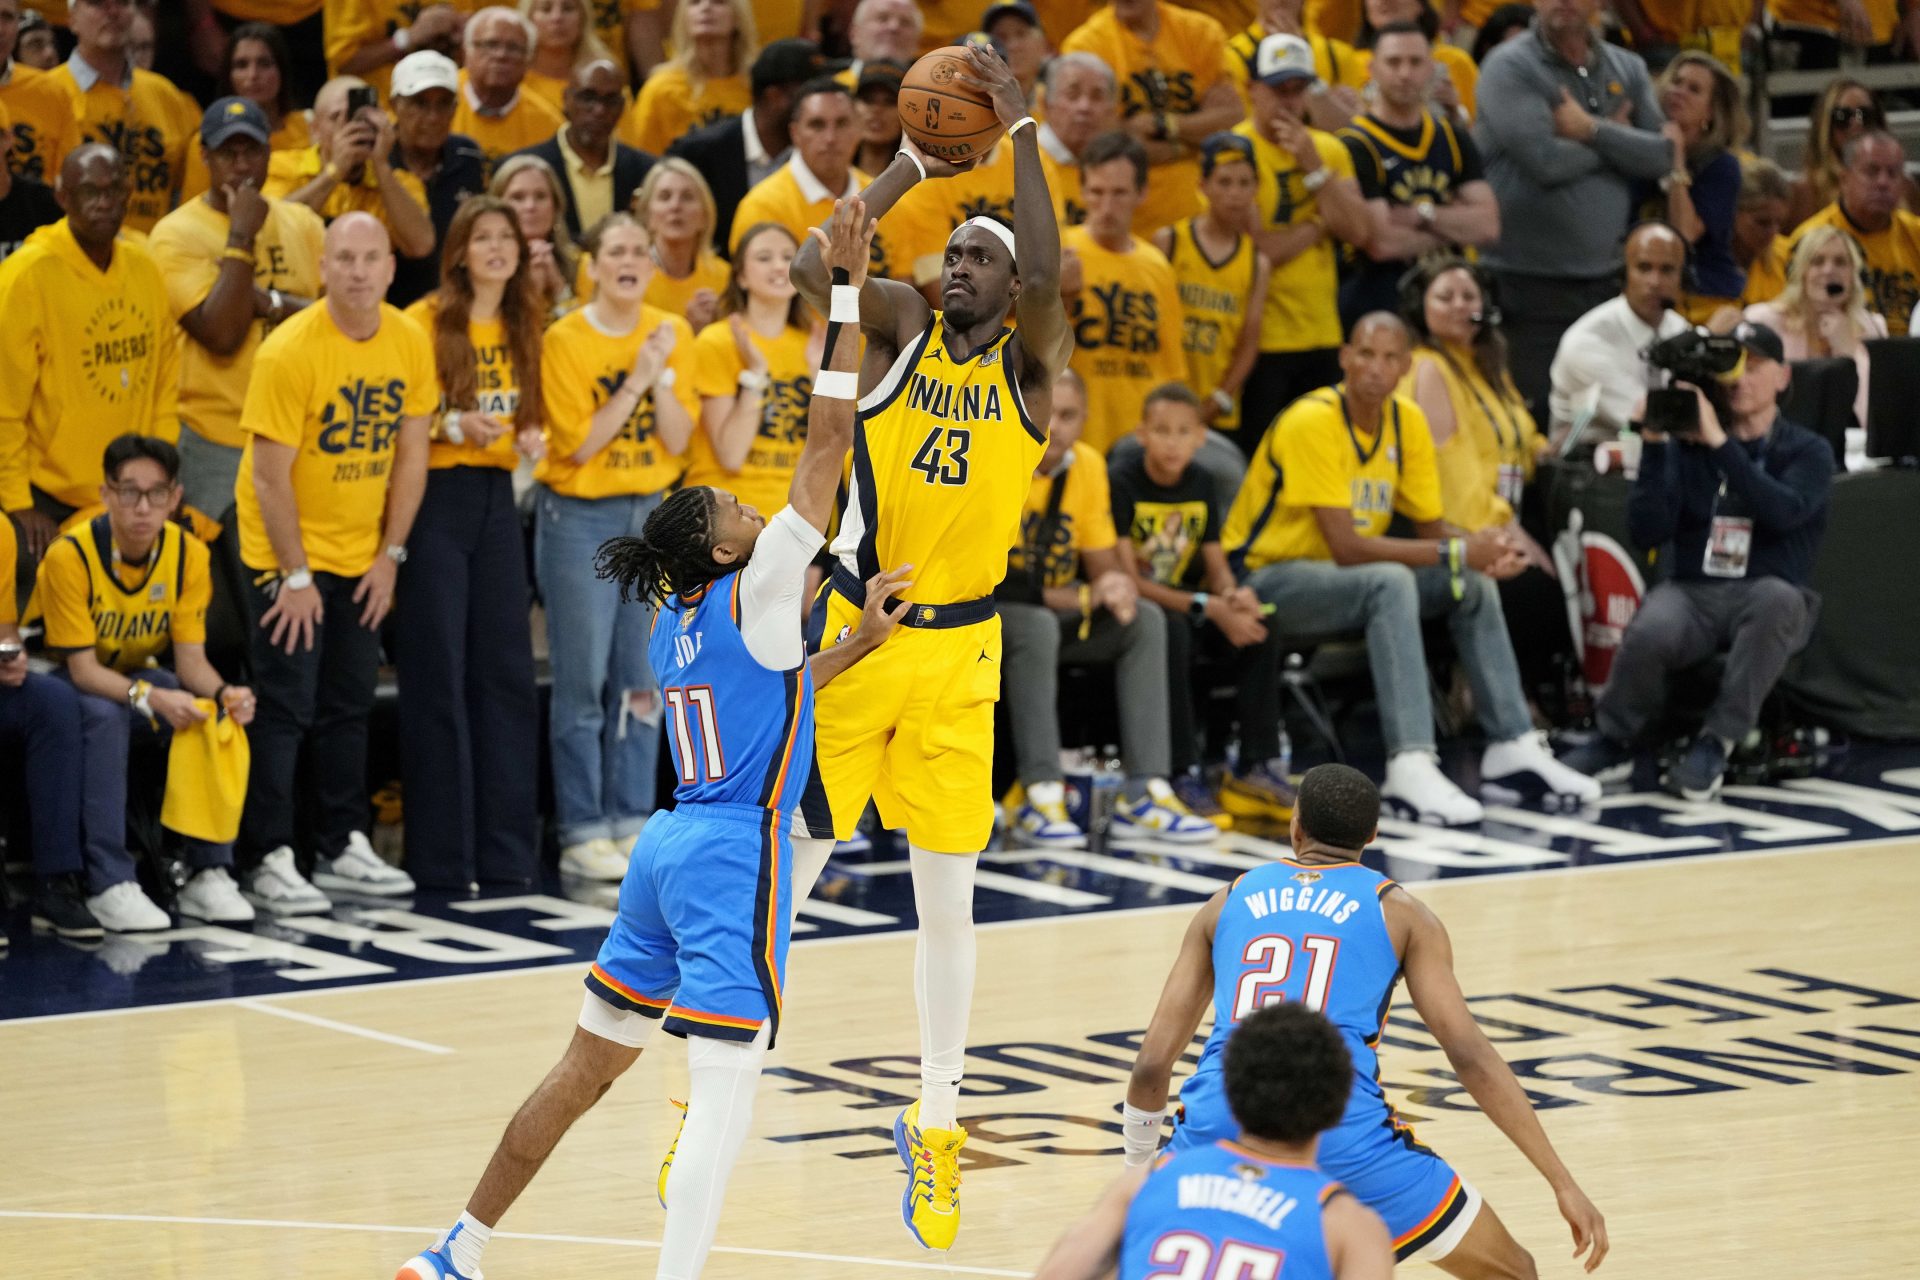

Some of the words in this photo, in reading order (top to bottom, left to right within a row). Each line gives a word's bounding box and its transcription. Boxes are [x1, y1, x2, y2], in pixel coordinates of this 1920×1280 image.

[1091, 281, 1158, 321] YES
[94, 332, 147, 366] PACERS
[338, 378, 406, 420] YES
[910, 426, 972, 488] 43
[664, 684, 727, 785] 11
[1244, 886, 1360, 925] WIGGINS
[1230, 932, 1342, 1024] 21
[1177, 1173, 1299, 1231] MITCHELL
